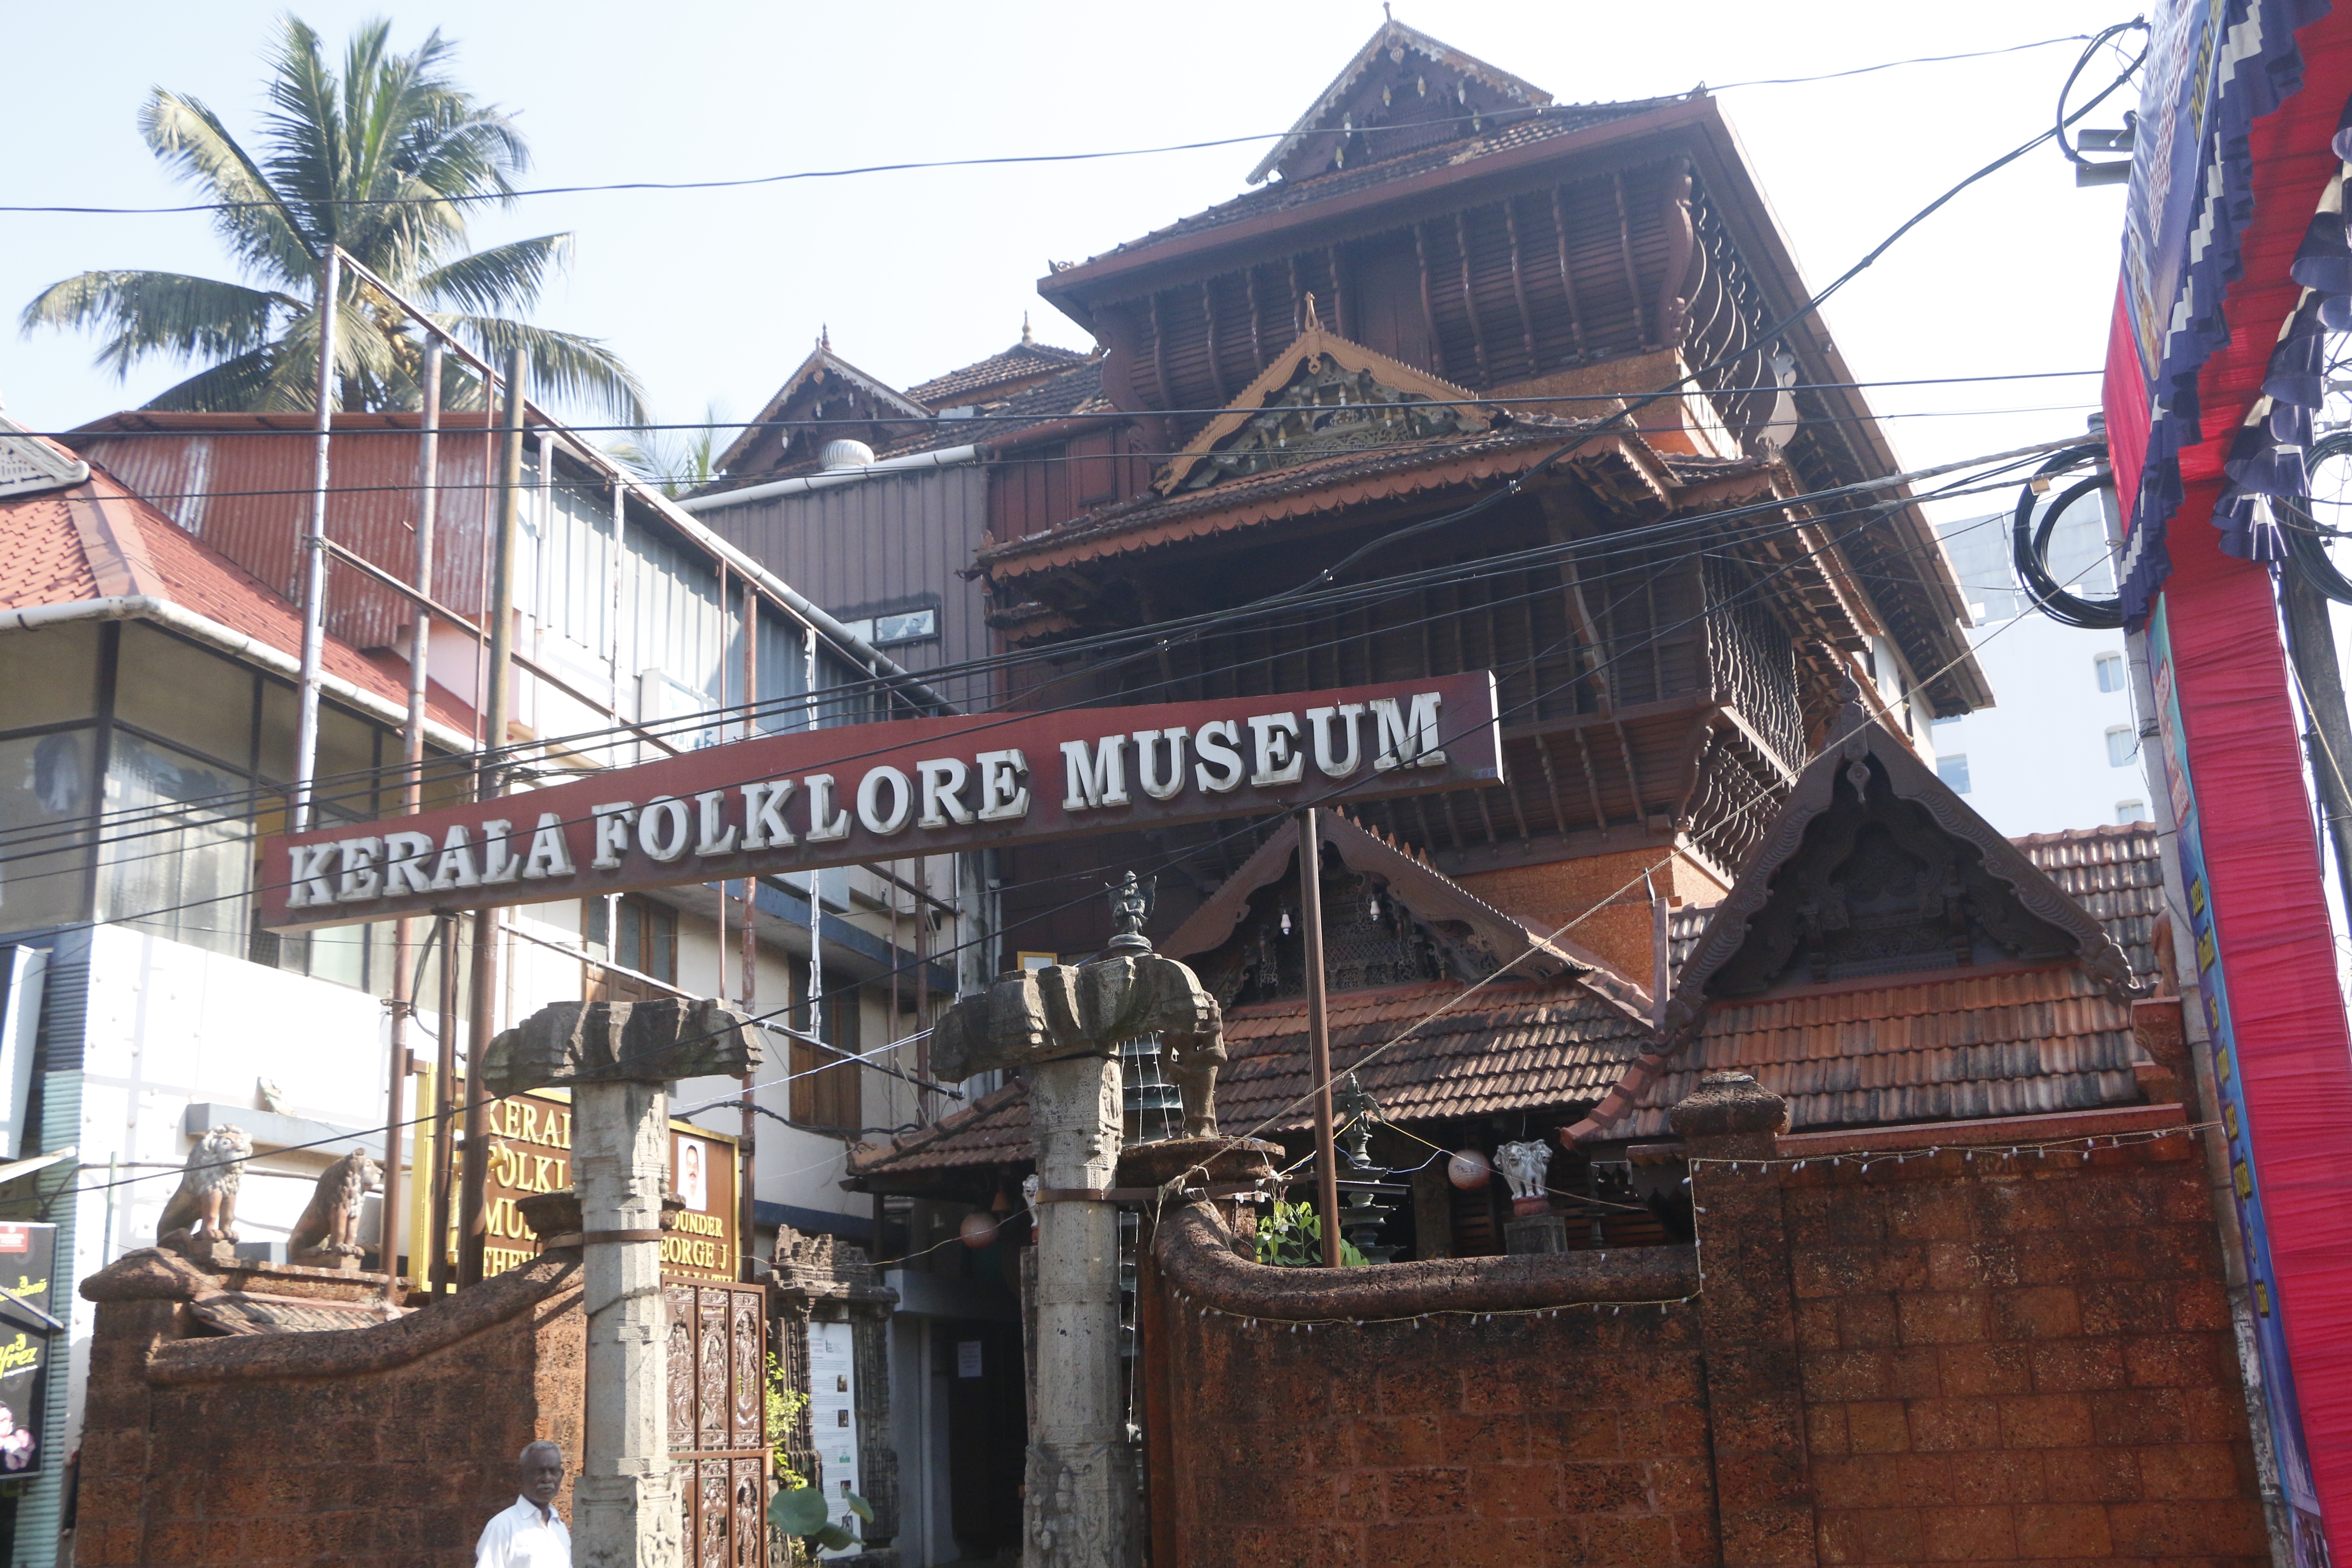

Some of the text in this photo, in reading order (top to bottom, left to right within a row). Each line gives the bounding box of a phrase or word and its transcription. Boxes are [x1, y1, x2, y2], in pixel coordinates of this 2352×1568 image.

[285, 692, 1447, 909] KERALA FOLKLORE MUSEUM
[719, 1244, 728, 1269] J
